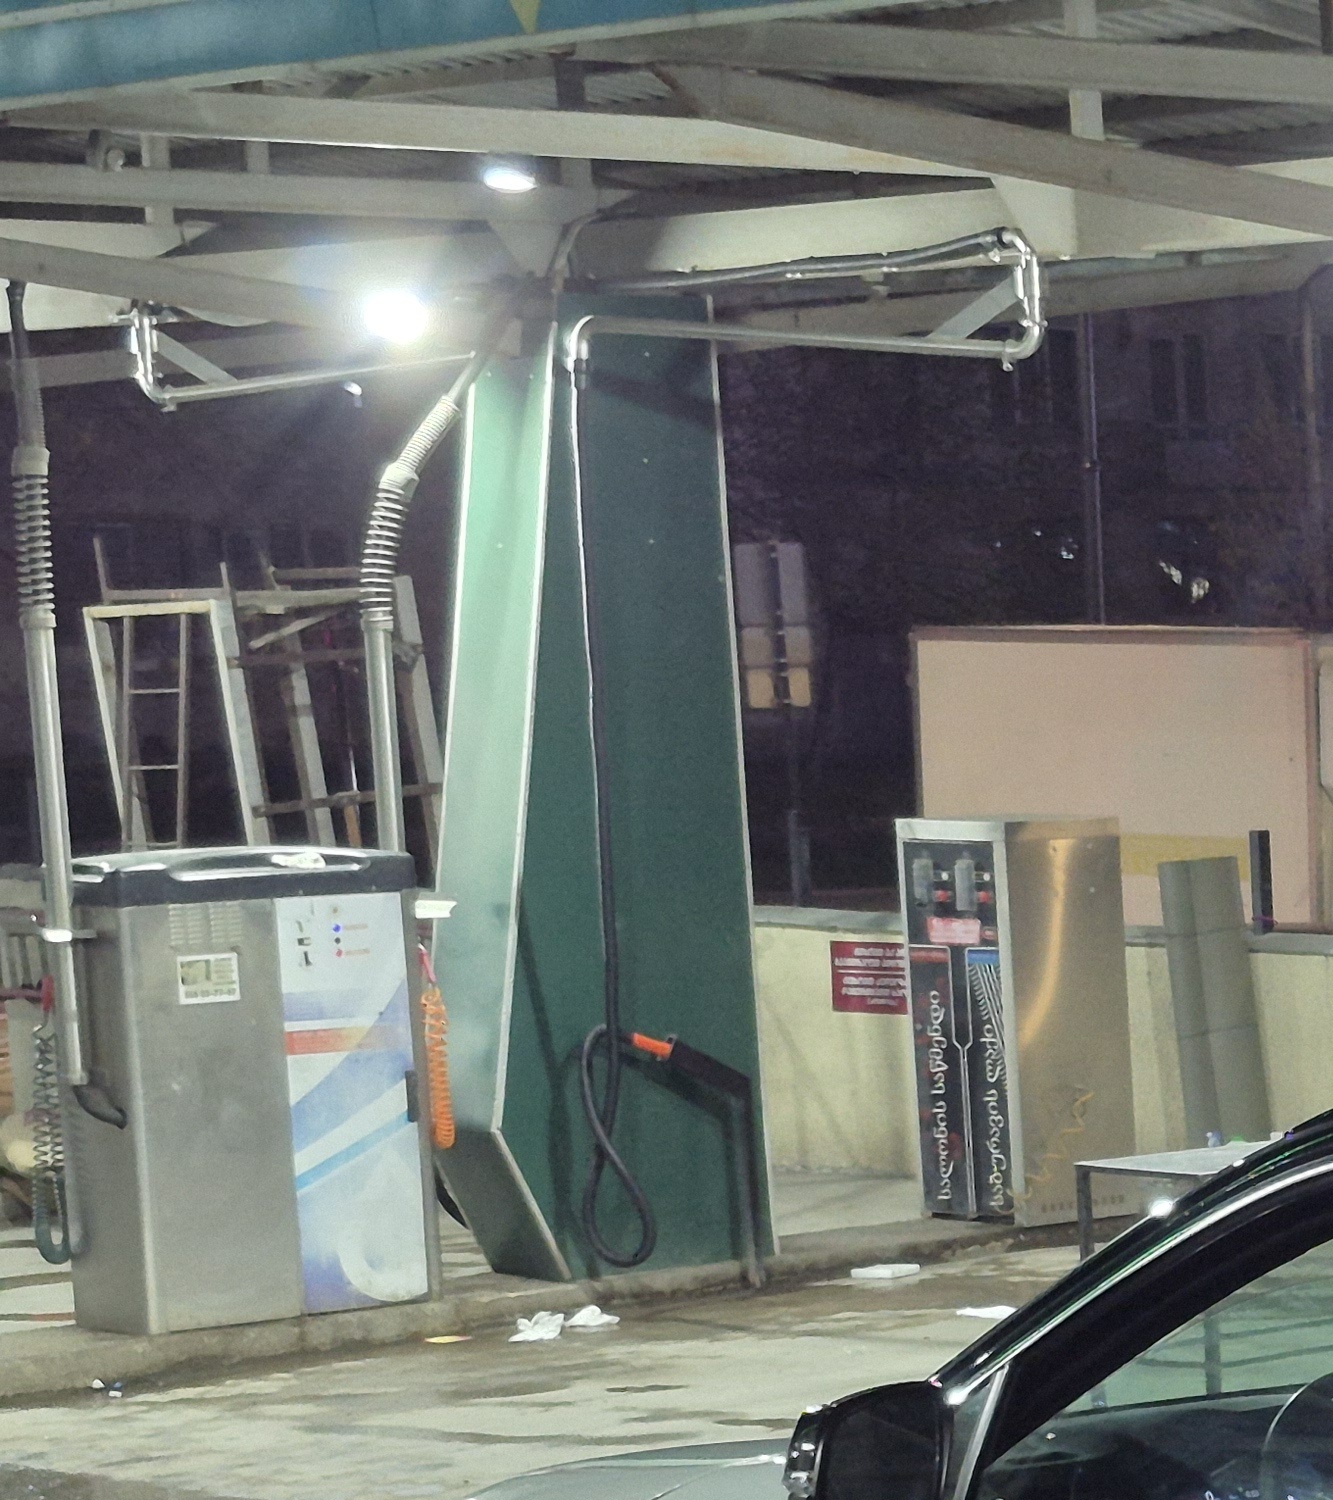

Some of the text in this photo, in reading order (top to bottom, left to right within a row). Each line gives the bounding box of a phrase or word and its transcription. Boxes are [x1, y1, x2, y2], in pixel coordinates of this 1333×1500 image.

[926, 990, 953, 1200] სალონის საწმენდი
[979, 1023, 1007, 1206] საბურავის ლაქი
